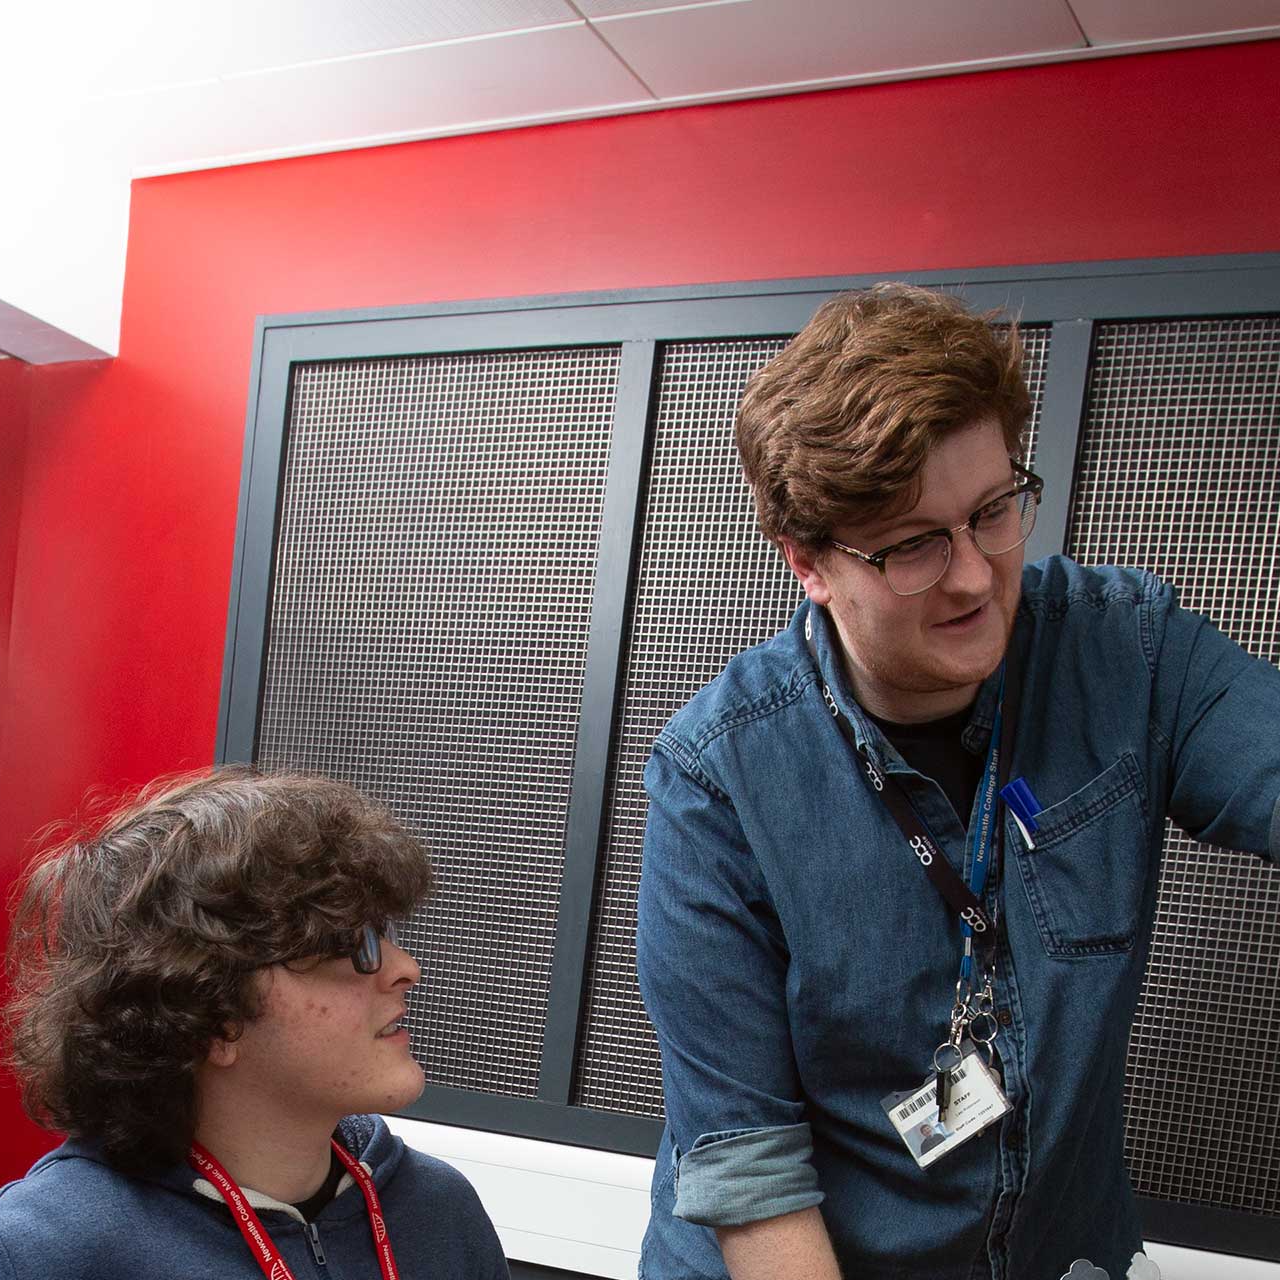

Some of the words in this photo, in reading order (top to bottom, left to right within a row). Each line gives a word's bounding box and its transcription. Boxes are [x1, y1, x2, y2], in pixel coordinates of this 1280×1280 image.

[989, 748, 998, 772] Staff
[983, 774, 996, 810] College
[212, 1168, 231, 1190] Music
[229, 1190, 249, 1221] College
